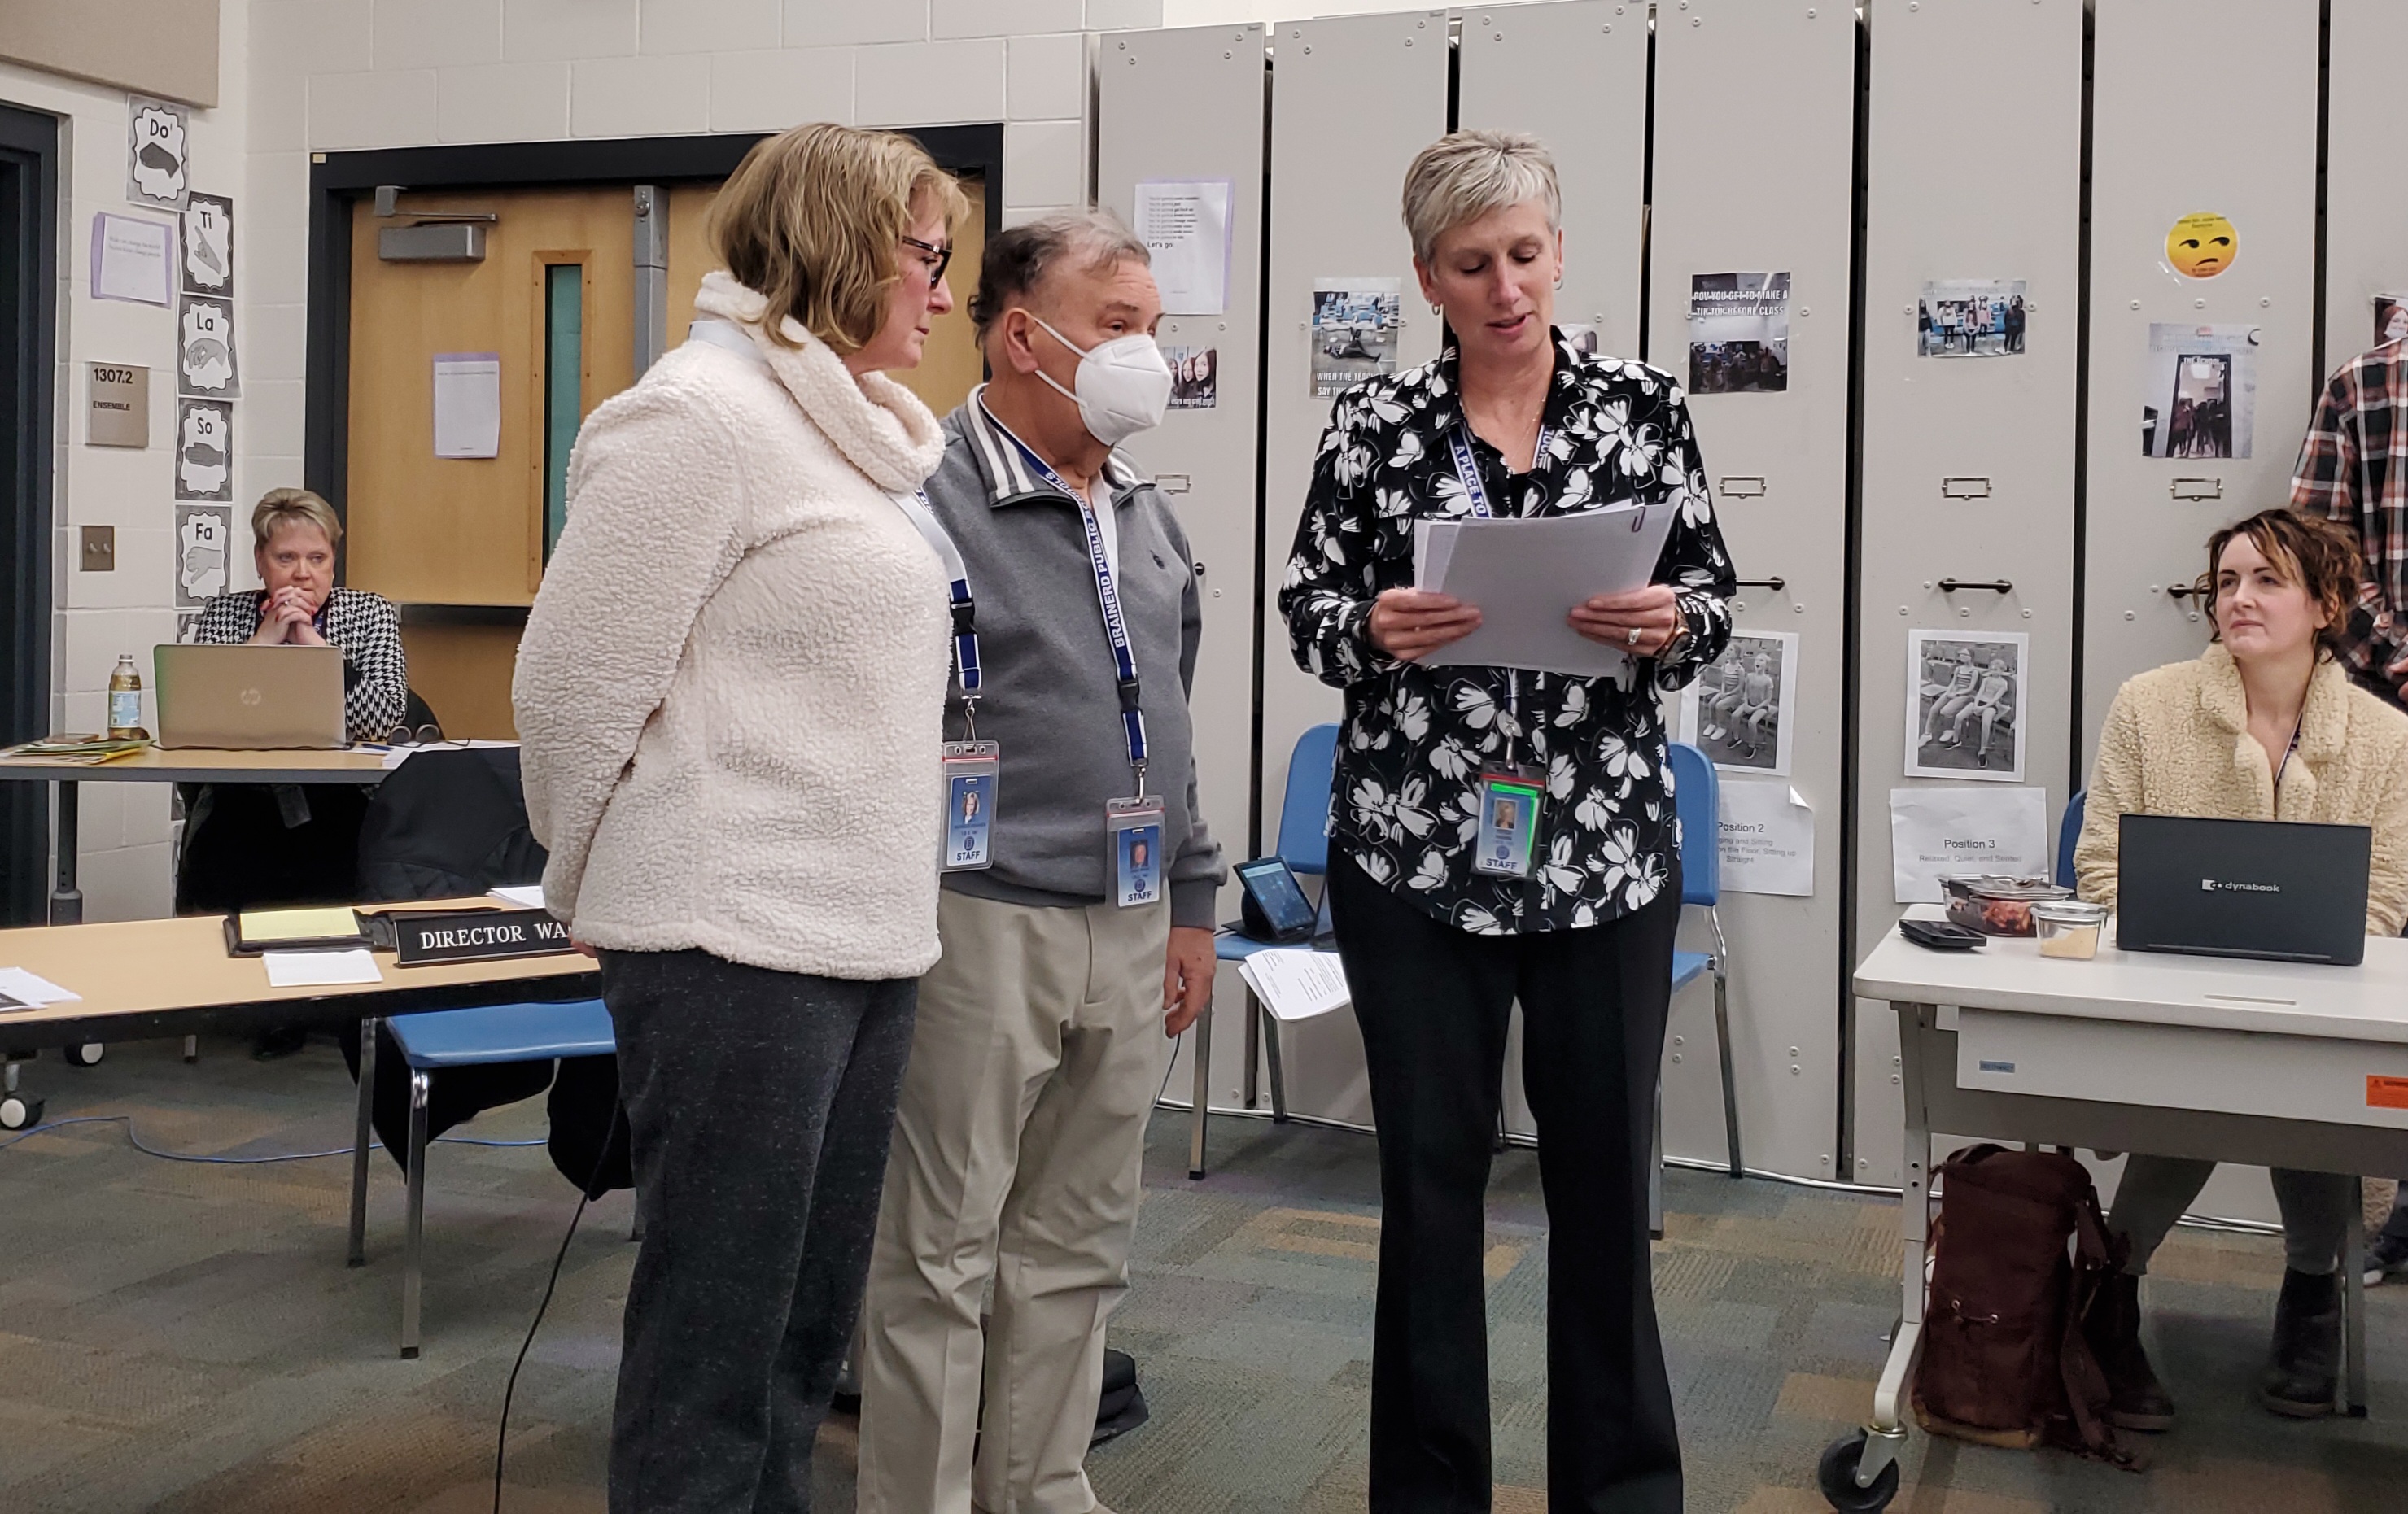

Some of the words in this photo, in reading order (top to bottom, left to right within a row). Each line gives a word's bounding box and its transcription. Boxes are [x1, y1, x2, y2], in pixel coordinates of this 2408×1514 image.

[200, 211, 212, 229] Ti
[1711, 291, 1726, 300] YOU
[1728, 291, 1742, 300] GET
[1745, 290, 1755, 300] TO
[1782, 290, 1788, 299] A
[1759, 306, 1785, 316] CLASS
[197, 312, 213, 331] La
[94, 368, 133, 384] 1307.2
[1316, 372, 1337, 381] WHEN
[1339, 372, 1352, 381] THE
[1317, 386, 1331, 396] SAY
[93, 401, 130, 411] ENSEMBLE
[198, 417, 212, 434] So
[1455, 446, 1465, 455] A
[1458, 456, 1477, 494] PLACE
[1473, 495, 1486, 514] TO
[196, 523, 212, 541] Fa
[1088, 522, 1108, 573] PUBLIC
[1101, 575, 1125, 648] BRAINERD
[1718, 822, 1755, 832] Position
[1758, 823, 1764, 833] 2
[1944, 839, 1986, 849] Position
[1989, 839, 1995, 849] 3
[956, 850, 981, 861] STAFF
[1485, 857, 1517, 870] STAFF
[2225, 881, 2280, 892] dynabook
[1127, 890, 1152, 901] STAFF
[420, 925, 527, 949] DIRECTOR
[533, 921, 571, 940] WA
